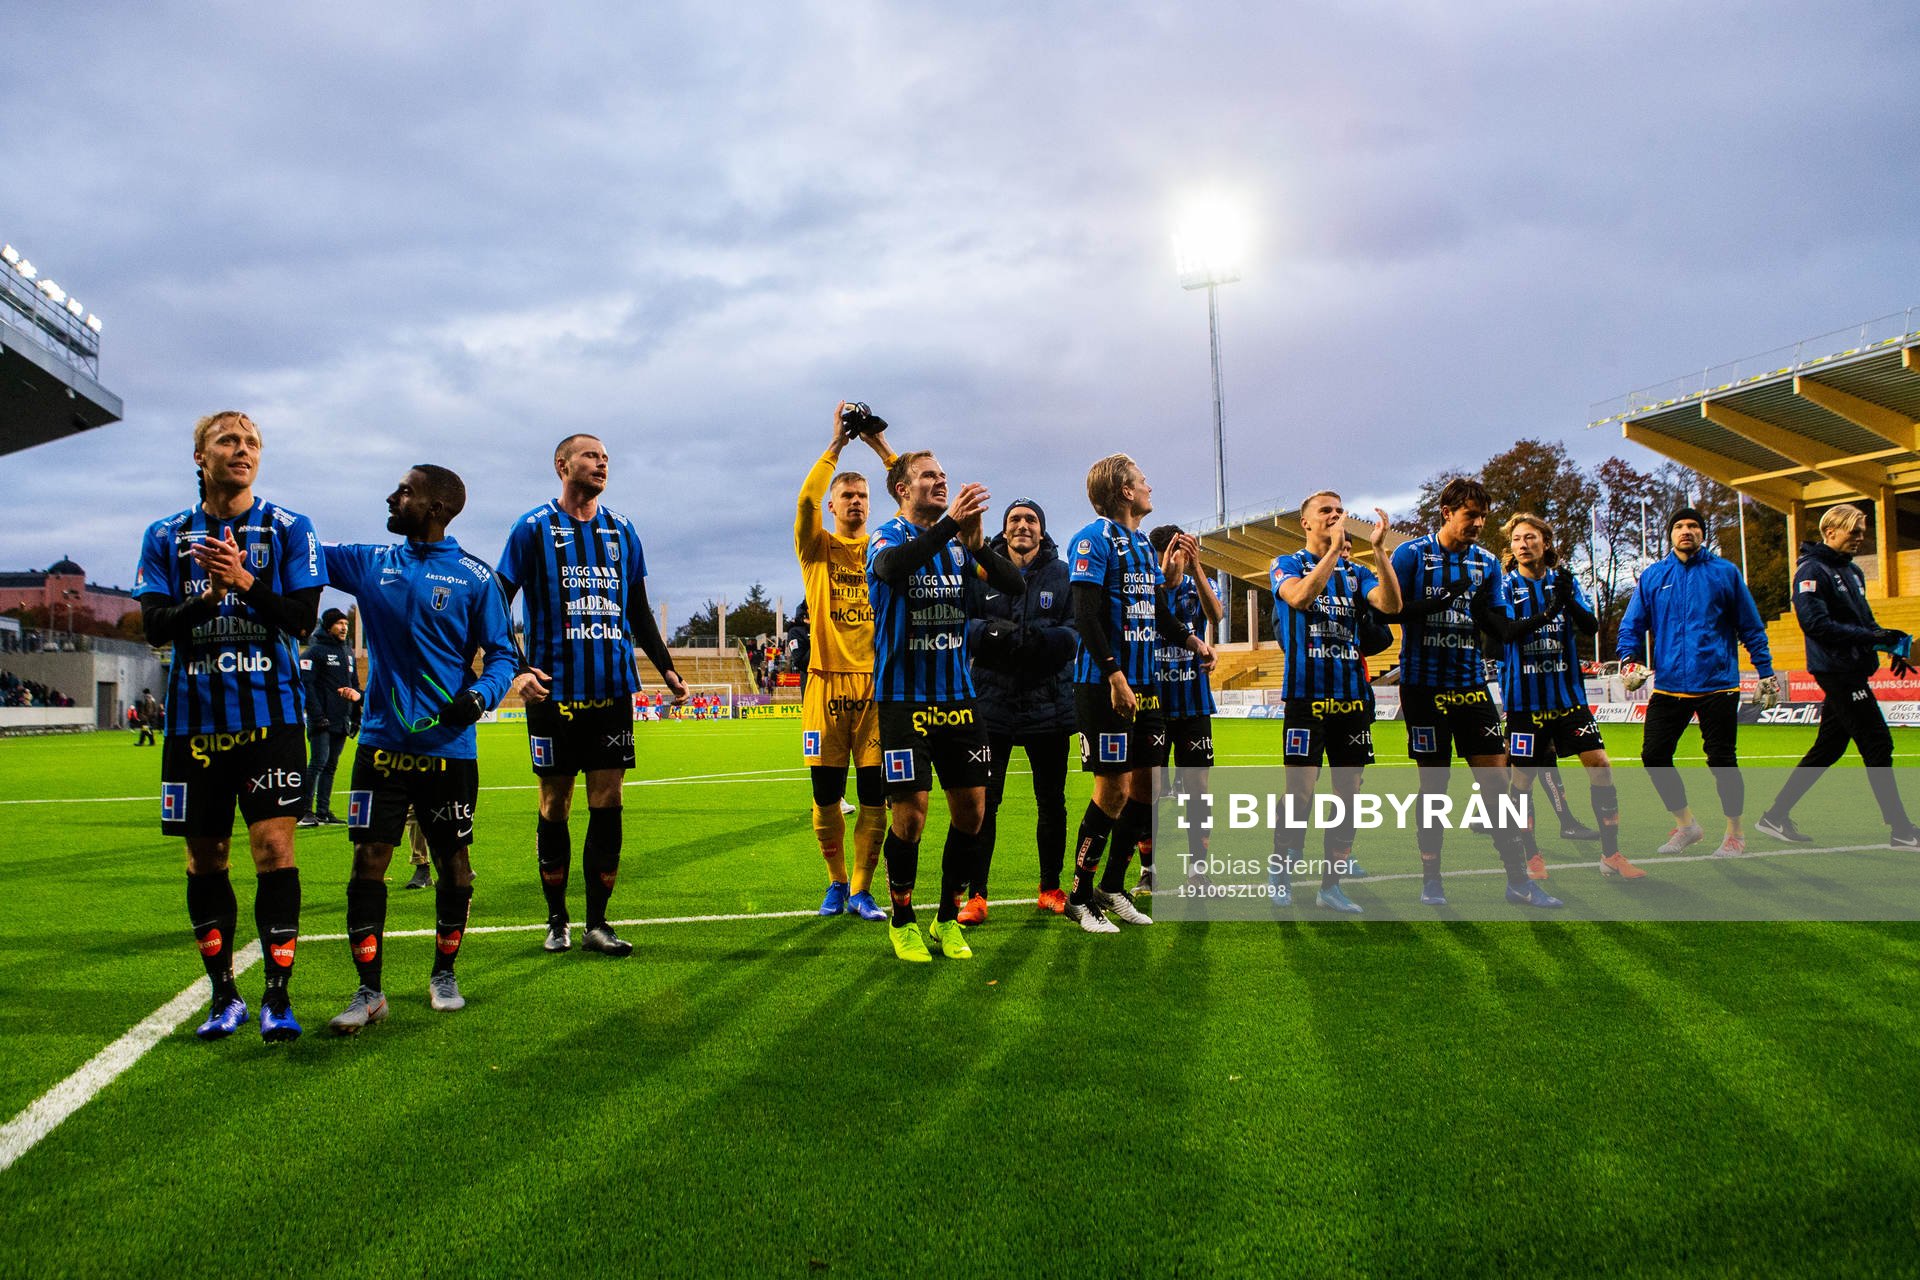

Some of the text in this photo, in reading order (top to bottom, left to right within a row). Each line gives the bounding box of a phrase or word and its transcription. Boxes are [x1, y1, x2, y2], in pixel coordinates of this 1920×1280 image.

[306, 531, 319, 577] stadium
[561, 566, 590, 577] BYGG
[908, 574, 938, 586] BYGG
[1123, 573, 1144, 583] BYGG
[561, 577, 620, 590] CONSTRUCT
[908, 587, 966, 599] CONSTRUCT
[564, 622, 623, 640] inkClub
[908, 632, 963, 651] inkClub
[1307, 643, 1360, 660] inkClub
[187, 651, 272, 675] inkClub
[1522, 659, 1569, 675] inkClub
[1154, 667, 1197, 682] nkClub
[1433, 690, 1488, 715] gibon
[1851, 689, 1869, 702] AH
[827, 694, 873, 721] gibon
[1311, 698, 1364, 721] gibon
[1757, 703, 1823, 724] stadiu
[911, 706, 974, 737] gibon
[250, 767, 303, 793] xite
